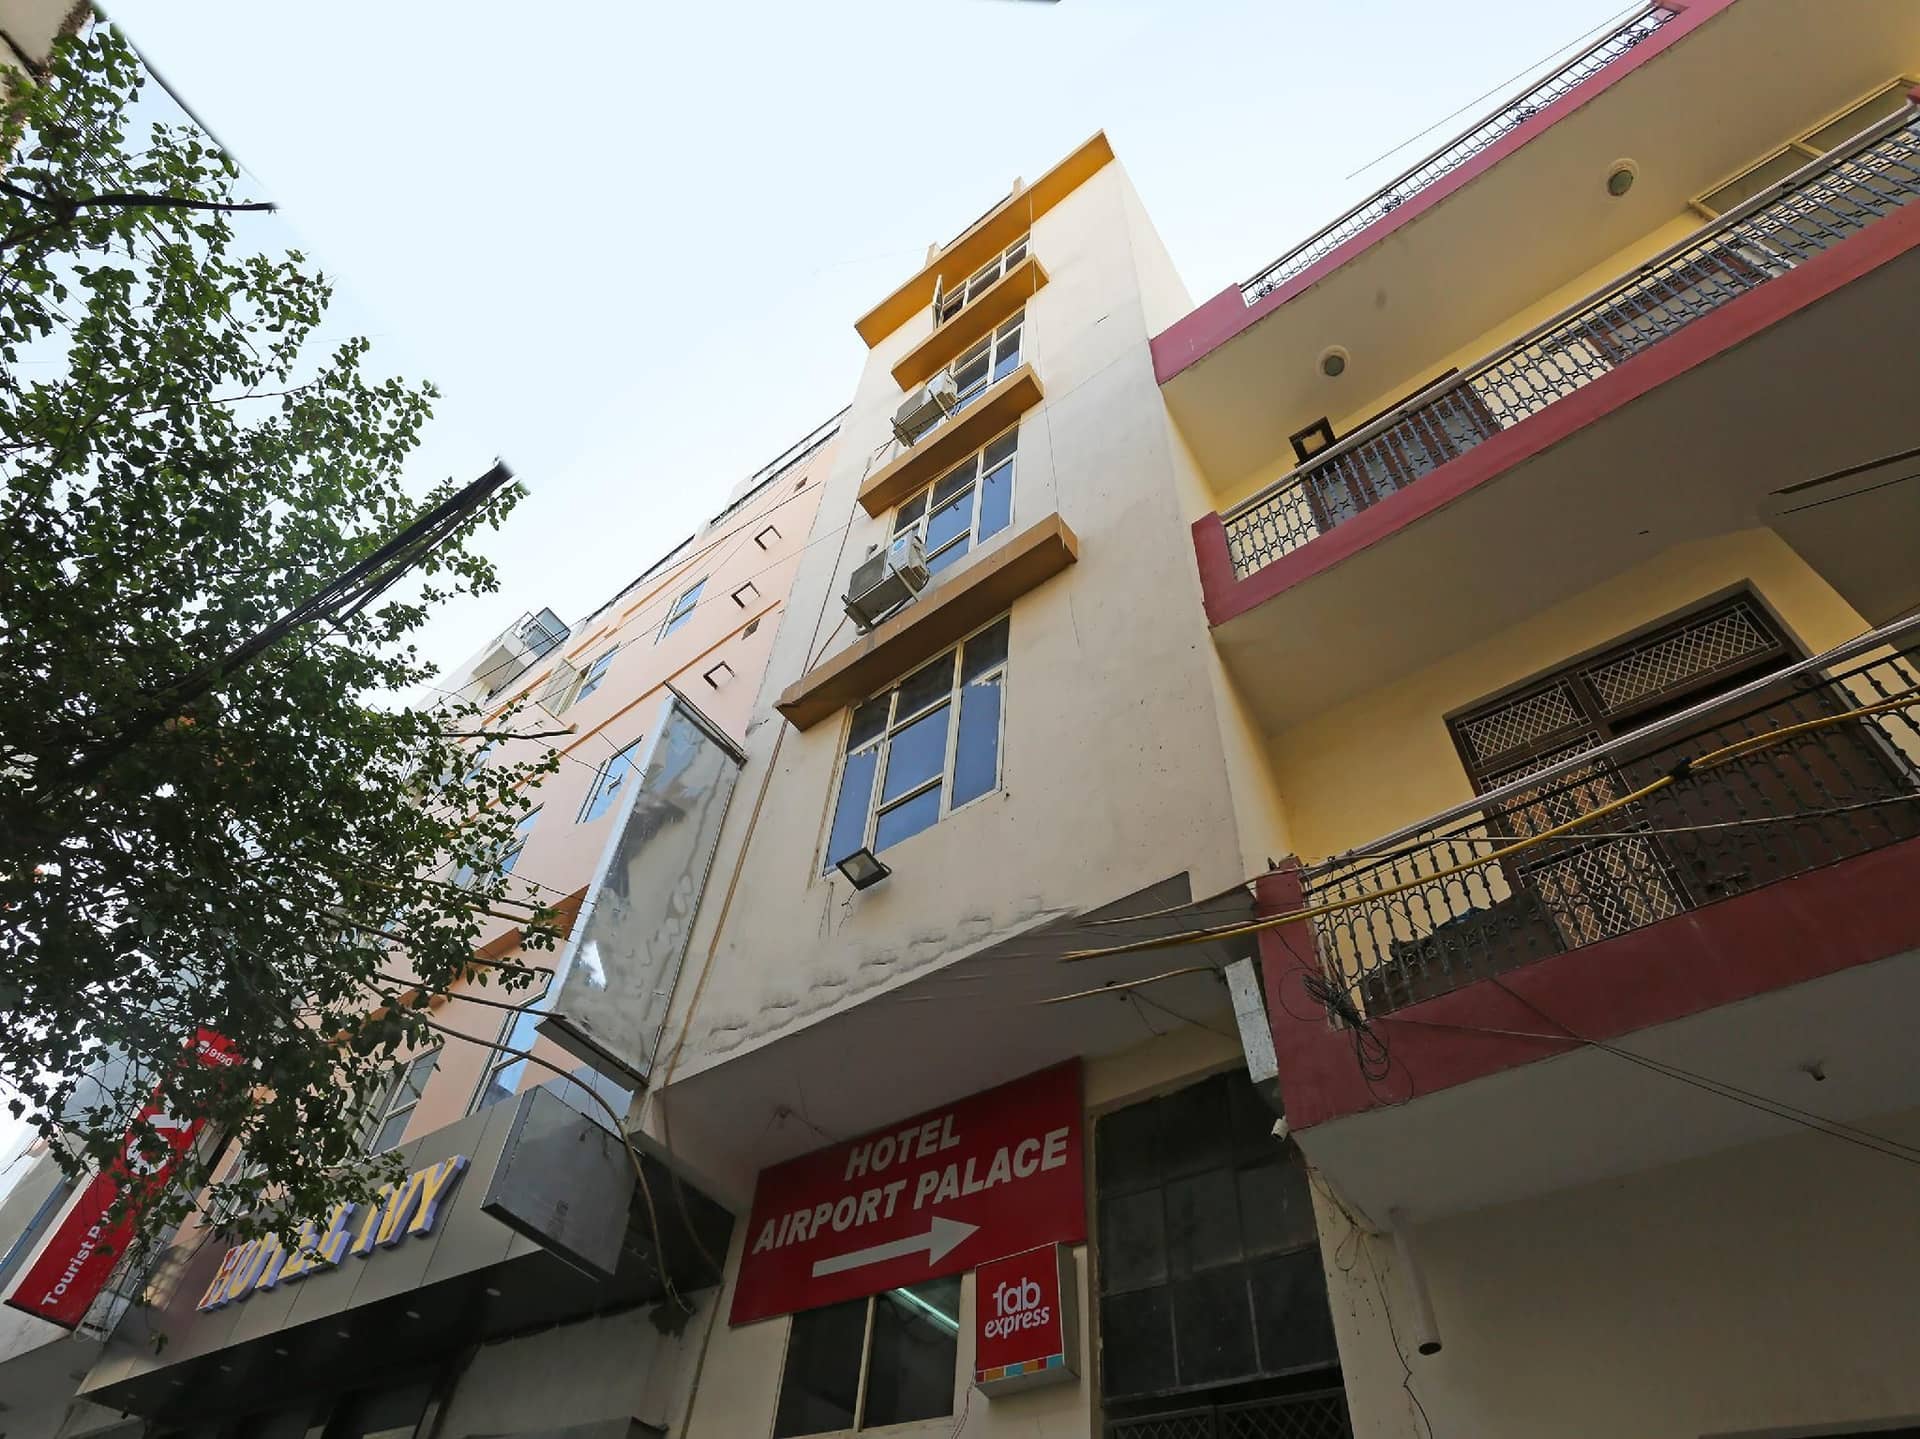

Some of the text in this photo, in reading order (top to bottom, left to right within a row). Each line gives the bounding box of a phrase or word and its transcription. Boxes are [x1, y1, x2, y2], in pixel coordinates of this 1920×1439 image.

[845, 1114, 960, 1181] HOTEL
[350, 1154, 468, 1258] IVY
[752, 1126, 1070, 1255] AIRPORT PALACE
[41, 1240, 96, 1305] Tourist
[992, 1276, 1041, 1317] fab
[984, 1306, 1050, 1339] express
